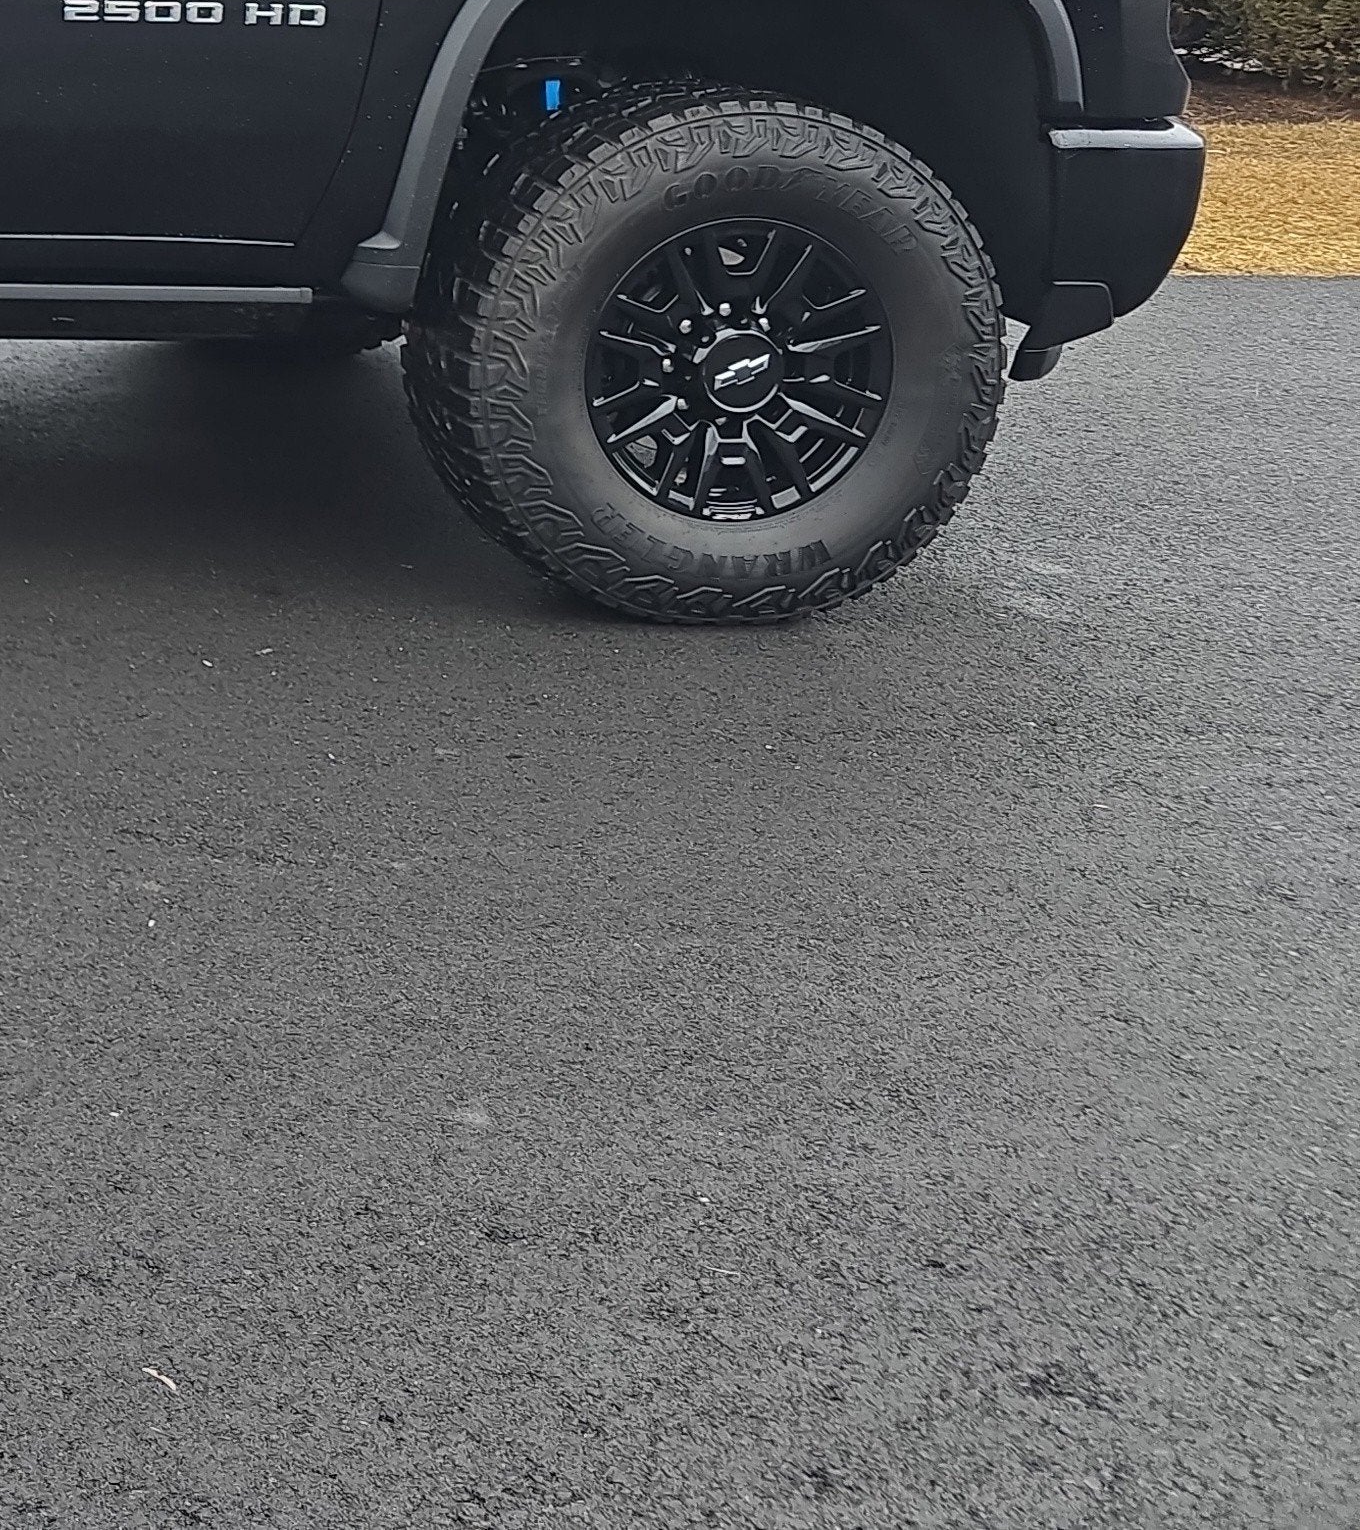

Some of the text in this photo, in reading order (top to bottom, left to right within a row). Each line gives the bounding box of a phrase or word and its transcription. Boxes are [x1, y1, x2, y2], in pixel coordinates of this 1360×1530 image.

[243, 2, 328, 27] HD
[664, 165, 919, 255] GOODYEAR
[591, 502, 832, 579] WRANGLER
